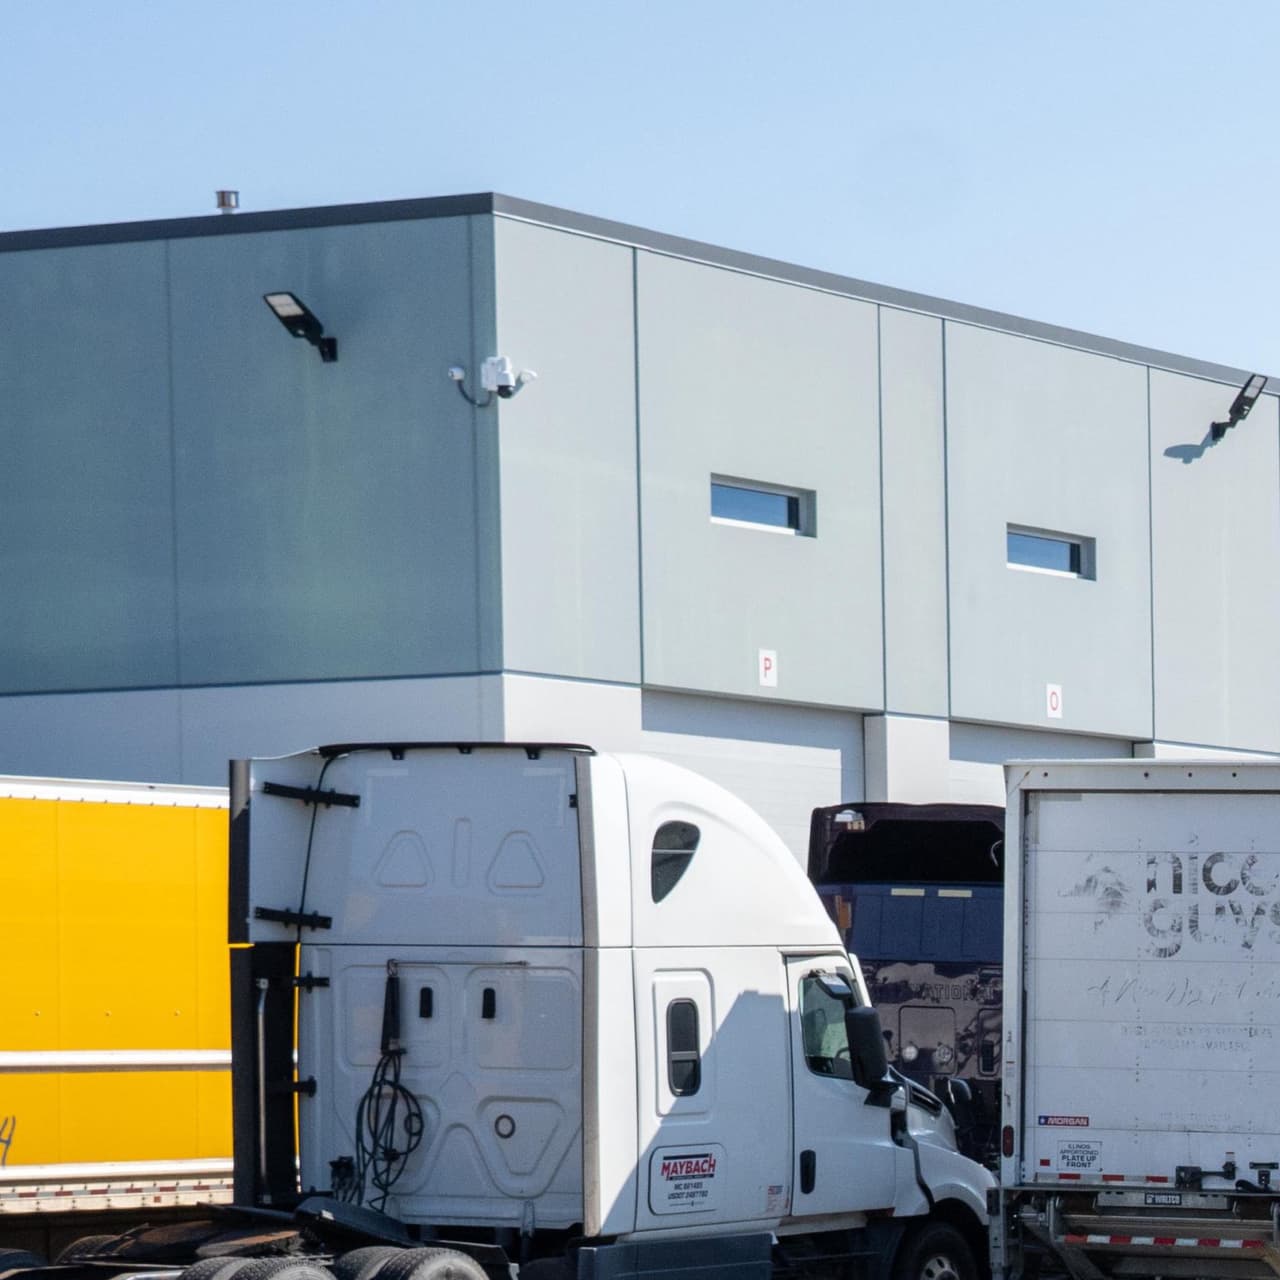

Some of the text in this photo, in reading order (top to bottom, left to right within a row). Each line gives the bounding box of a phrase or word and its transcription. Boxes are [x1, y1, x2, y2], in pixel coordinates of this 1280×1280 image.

[763, 657, 773, 678] P
[1047, 1117, 1088, 1126] MORGAN
[661, 1153, 717, 1181] MAYBACH
[1066, 1161, 1092, 1169] FRONT
